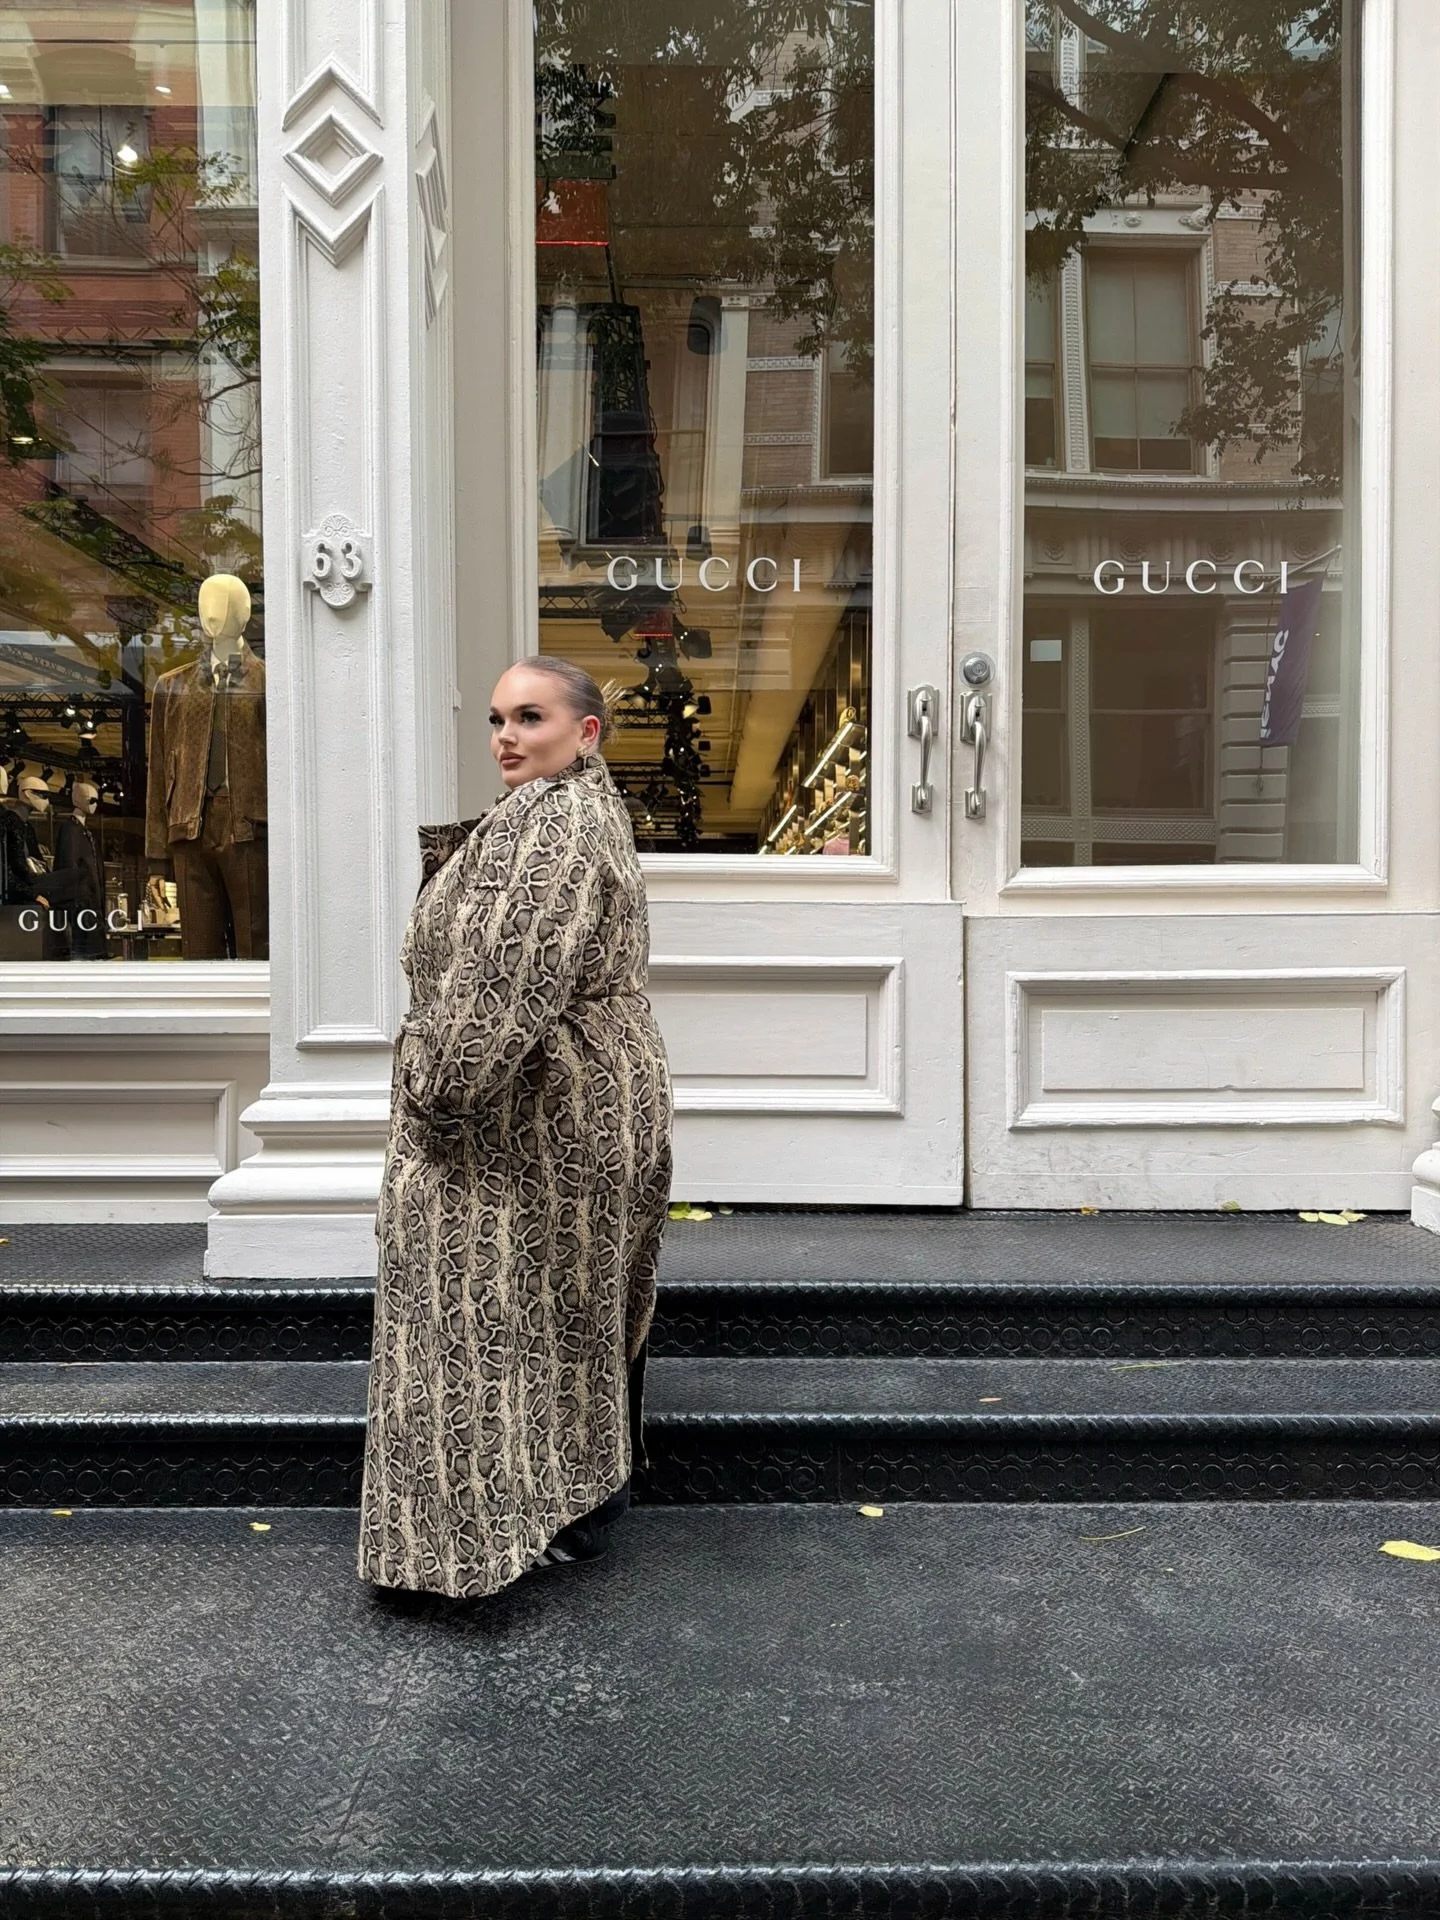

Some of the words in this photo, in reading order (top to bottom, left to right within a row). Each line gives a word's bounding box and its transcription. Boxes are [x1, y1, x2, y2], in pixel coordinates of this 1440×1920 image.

[311, 540, 363, 579] 63
[606, 556, 802, 593] GUCCI
[1093, 559, 1289, 594] GUCCI
[18, 909, 144, 932] GUCCI
